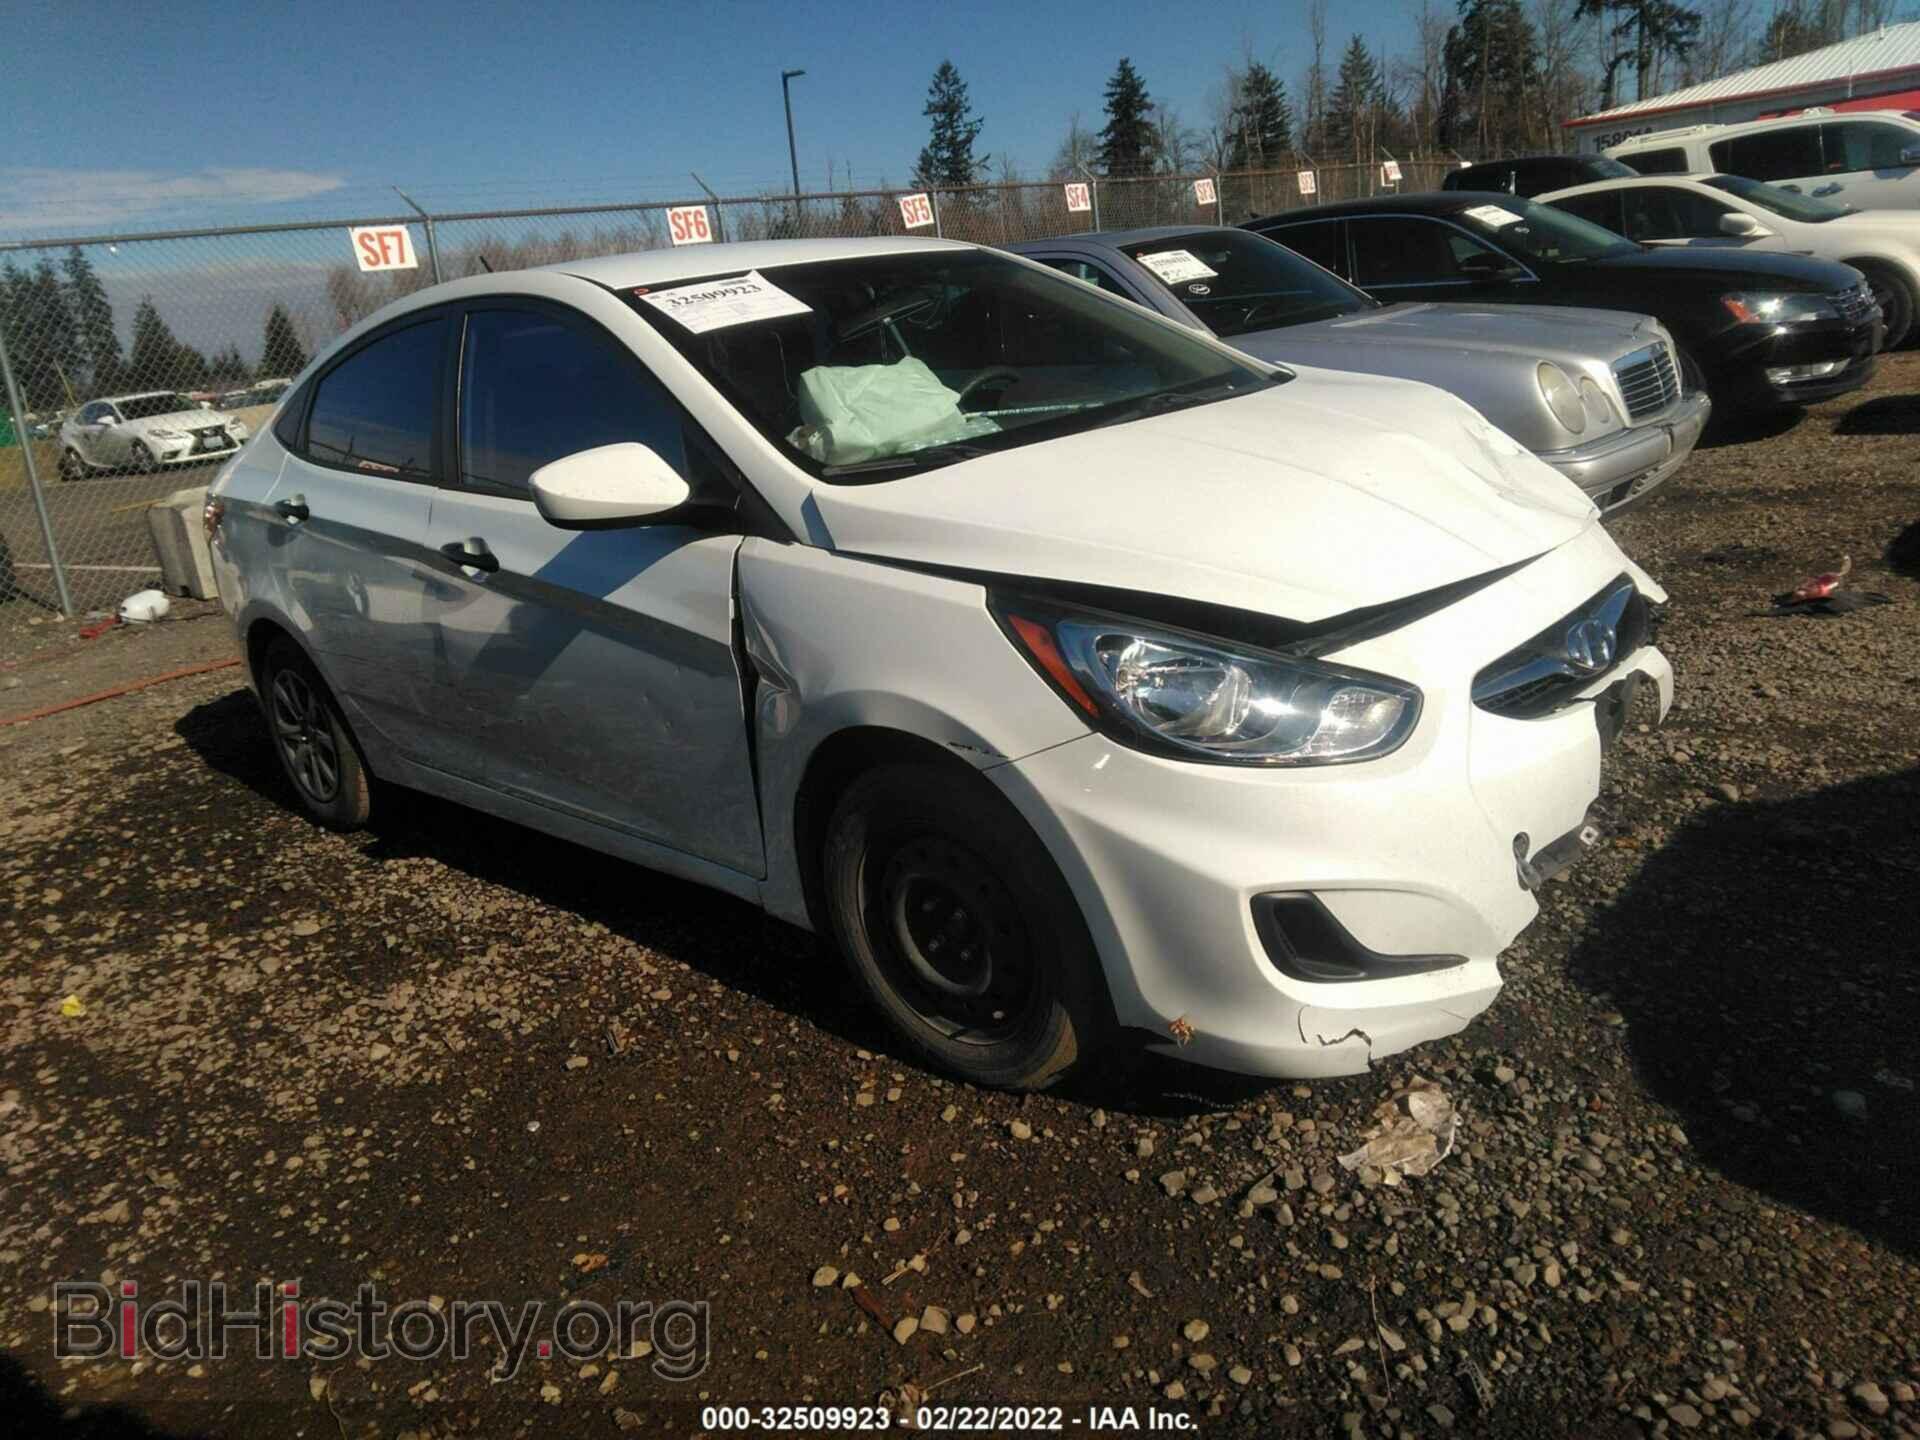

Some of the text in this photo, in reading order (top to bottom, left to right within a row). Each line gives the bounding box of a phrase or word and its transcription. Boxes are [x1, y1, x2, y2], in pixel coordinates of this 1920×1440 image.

[902, 197, 930, 224] SF5
[1068, 186, 1088, 208] SF4
[671, 210, 708, 241] SF6
[358, 231, 405, 267] SF7
[664, 284, 762, 308] 32509923
